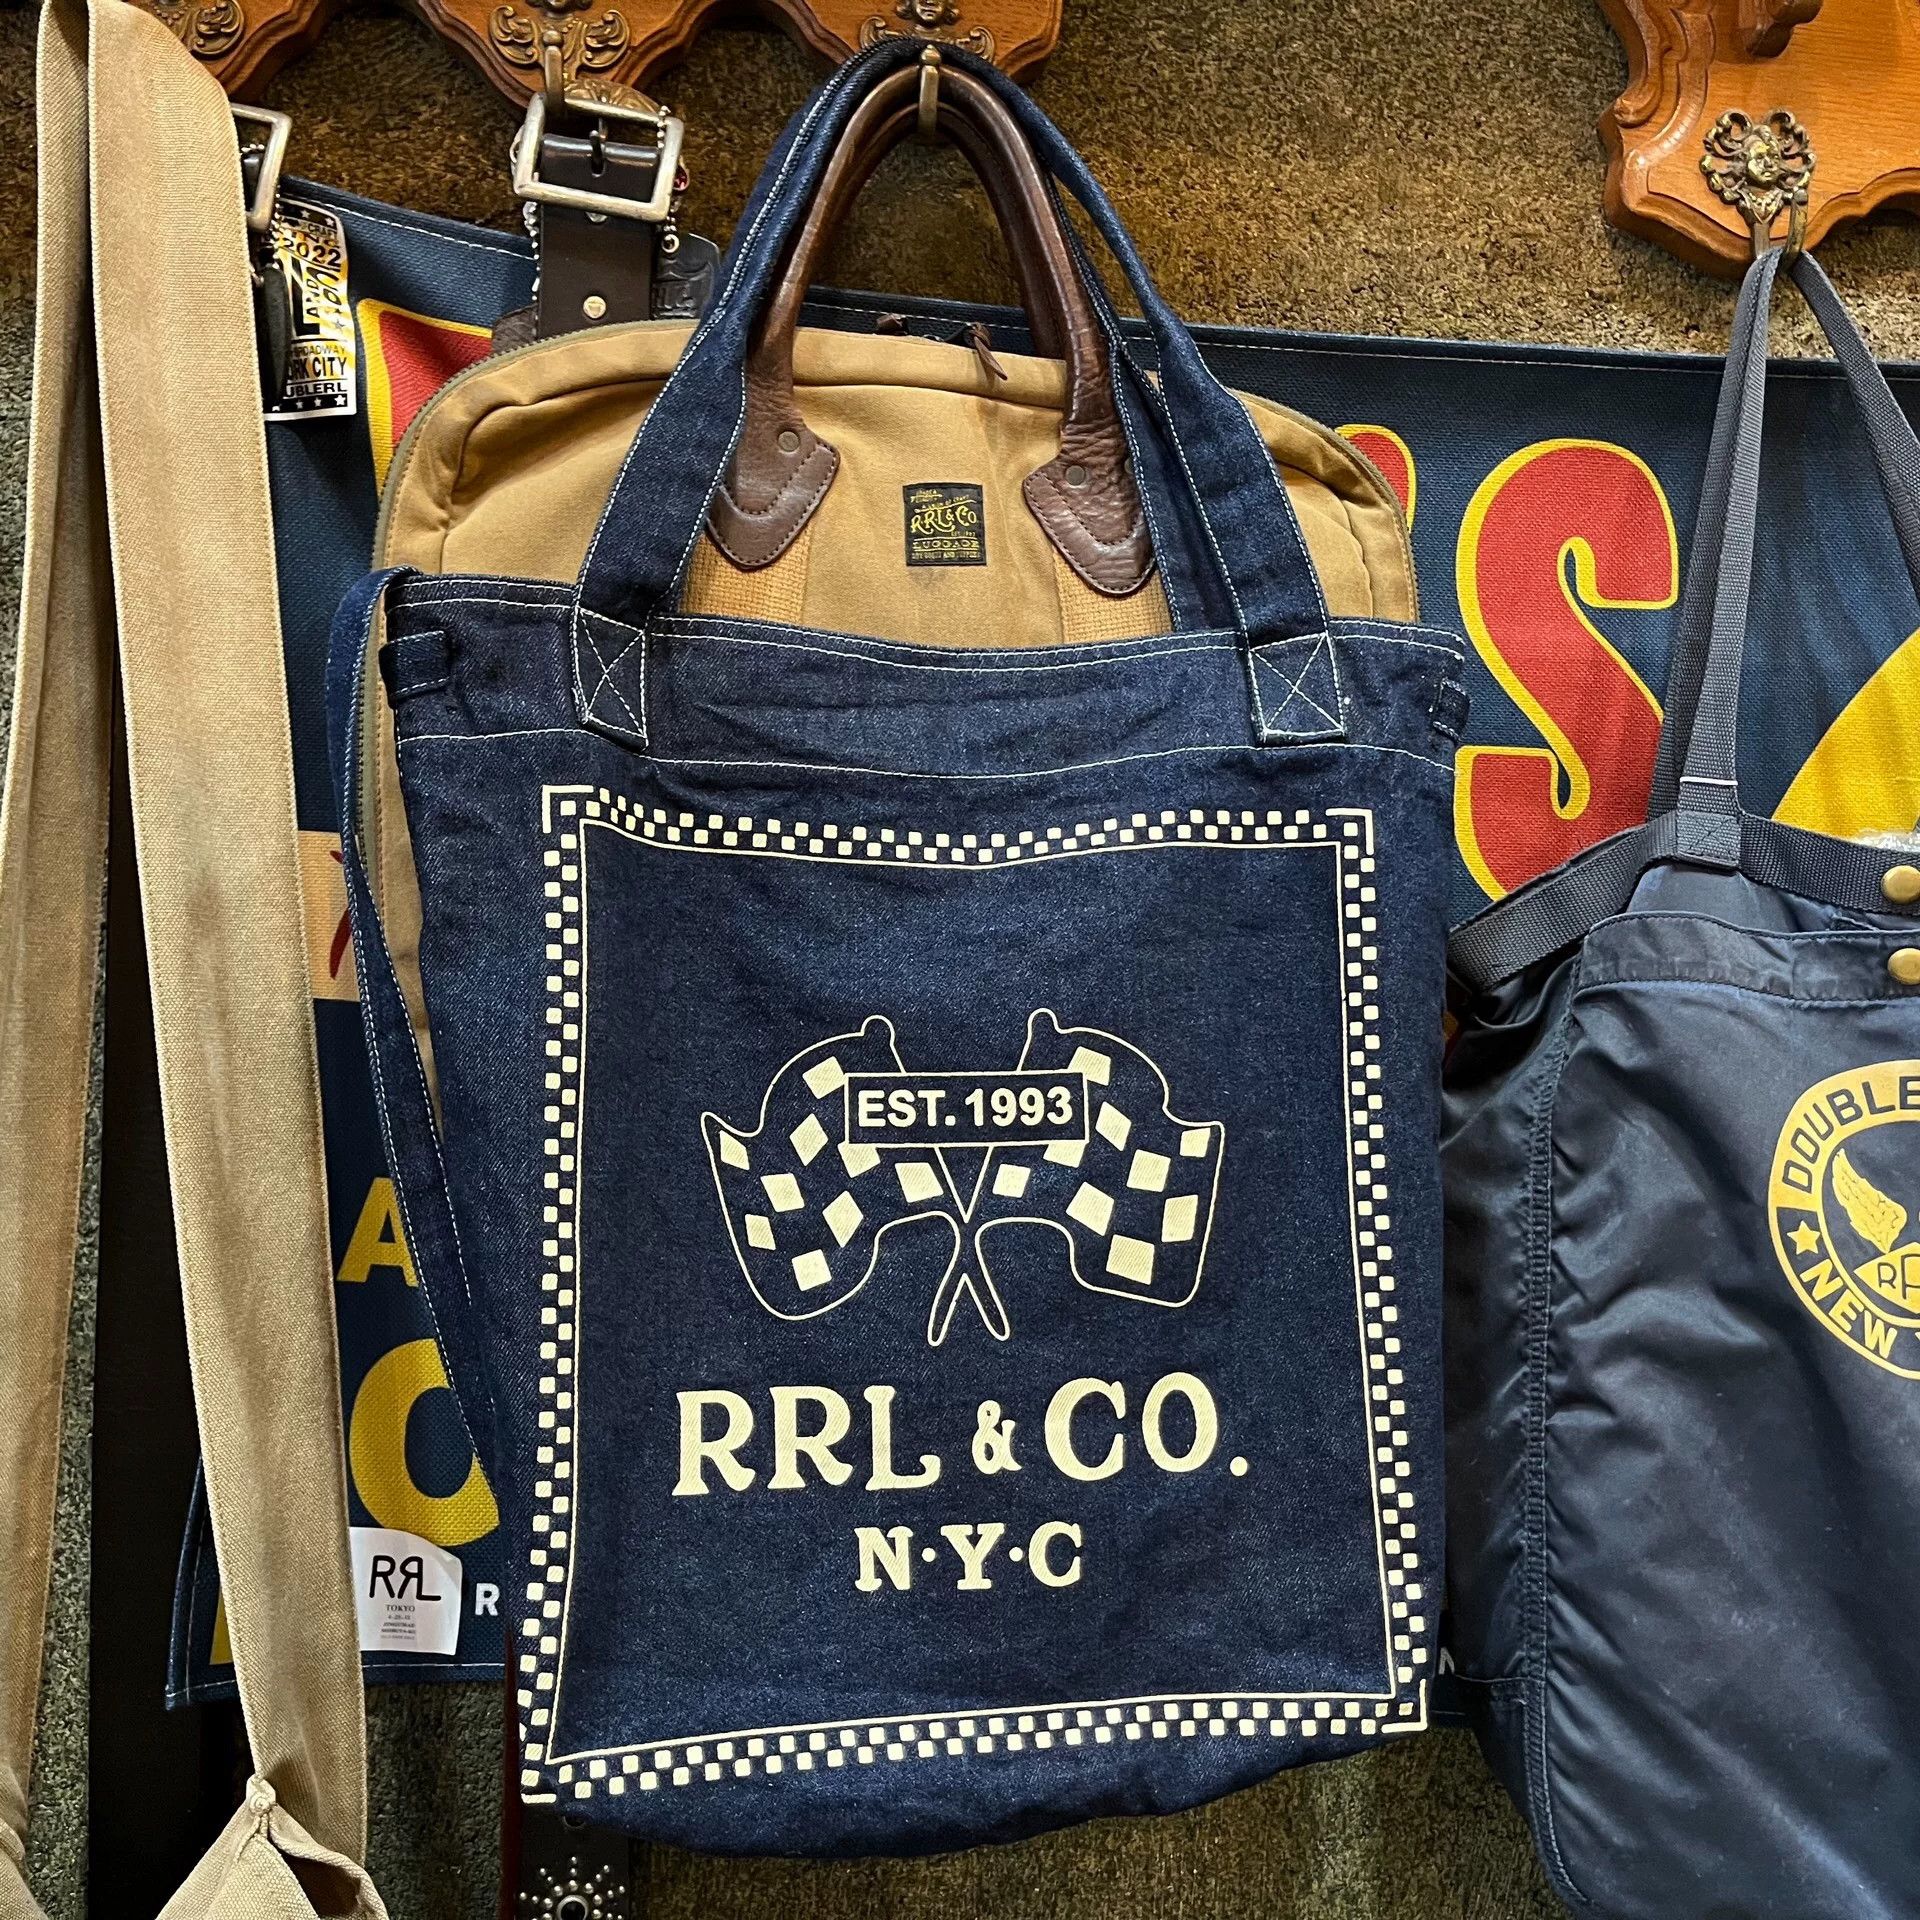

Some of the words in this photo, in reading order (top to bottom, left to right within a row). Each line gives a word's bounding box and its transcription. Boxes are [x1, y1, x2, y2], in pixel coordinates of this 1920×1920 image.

[281, 237, 341, 268] 2022
[312, 356, 346, 378] CITY
[858, 1089, 956, 1127] EST.
[965, 1086, 1073, 1127] 1993
[1799, 1258, 1898, 1360] NEW
[671, 1385, 941, 1496] RRL
[971, 1399, 1023, 1475] &
[1044, 1371, 1248, 1482] CO.
[385, 1604, 416, 1612] TOKYO
